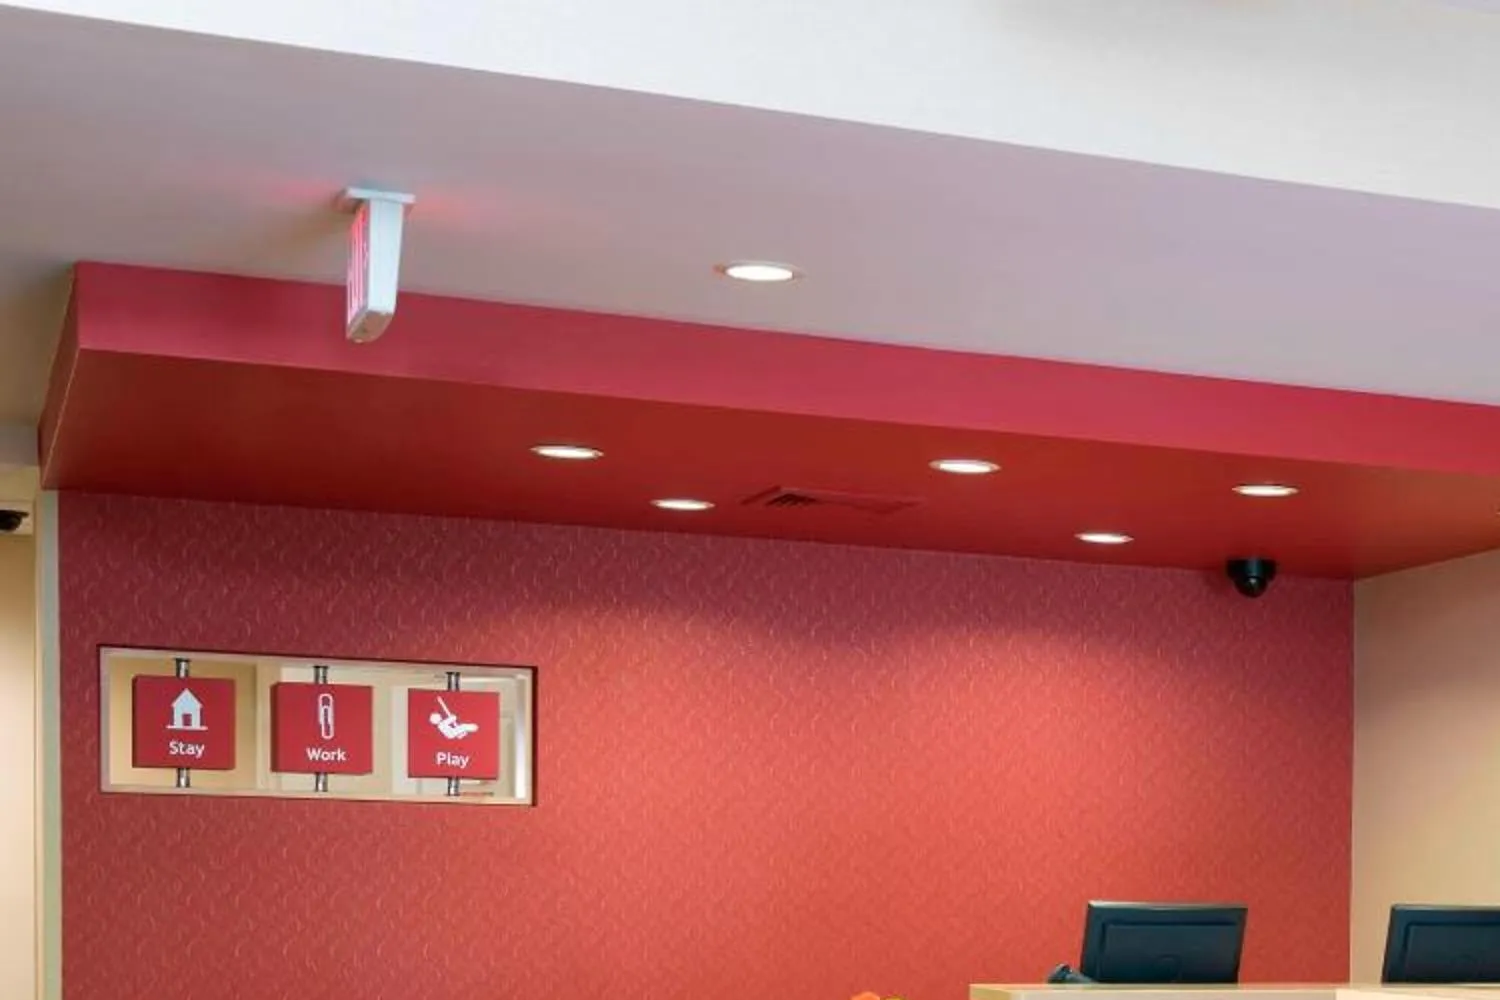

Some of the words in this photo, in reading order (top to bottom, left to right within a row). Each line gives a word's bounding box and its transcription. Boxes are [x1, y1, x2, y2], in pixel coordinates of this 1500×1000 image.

[169, 740, 206, 759] Stay
[306, 747, 347, 762] Work
[436, 751, 470, 768] Play
